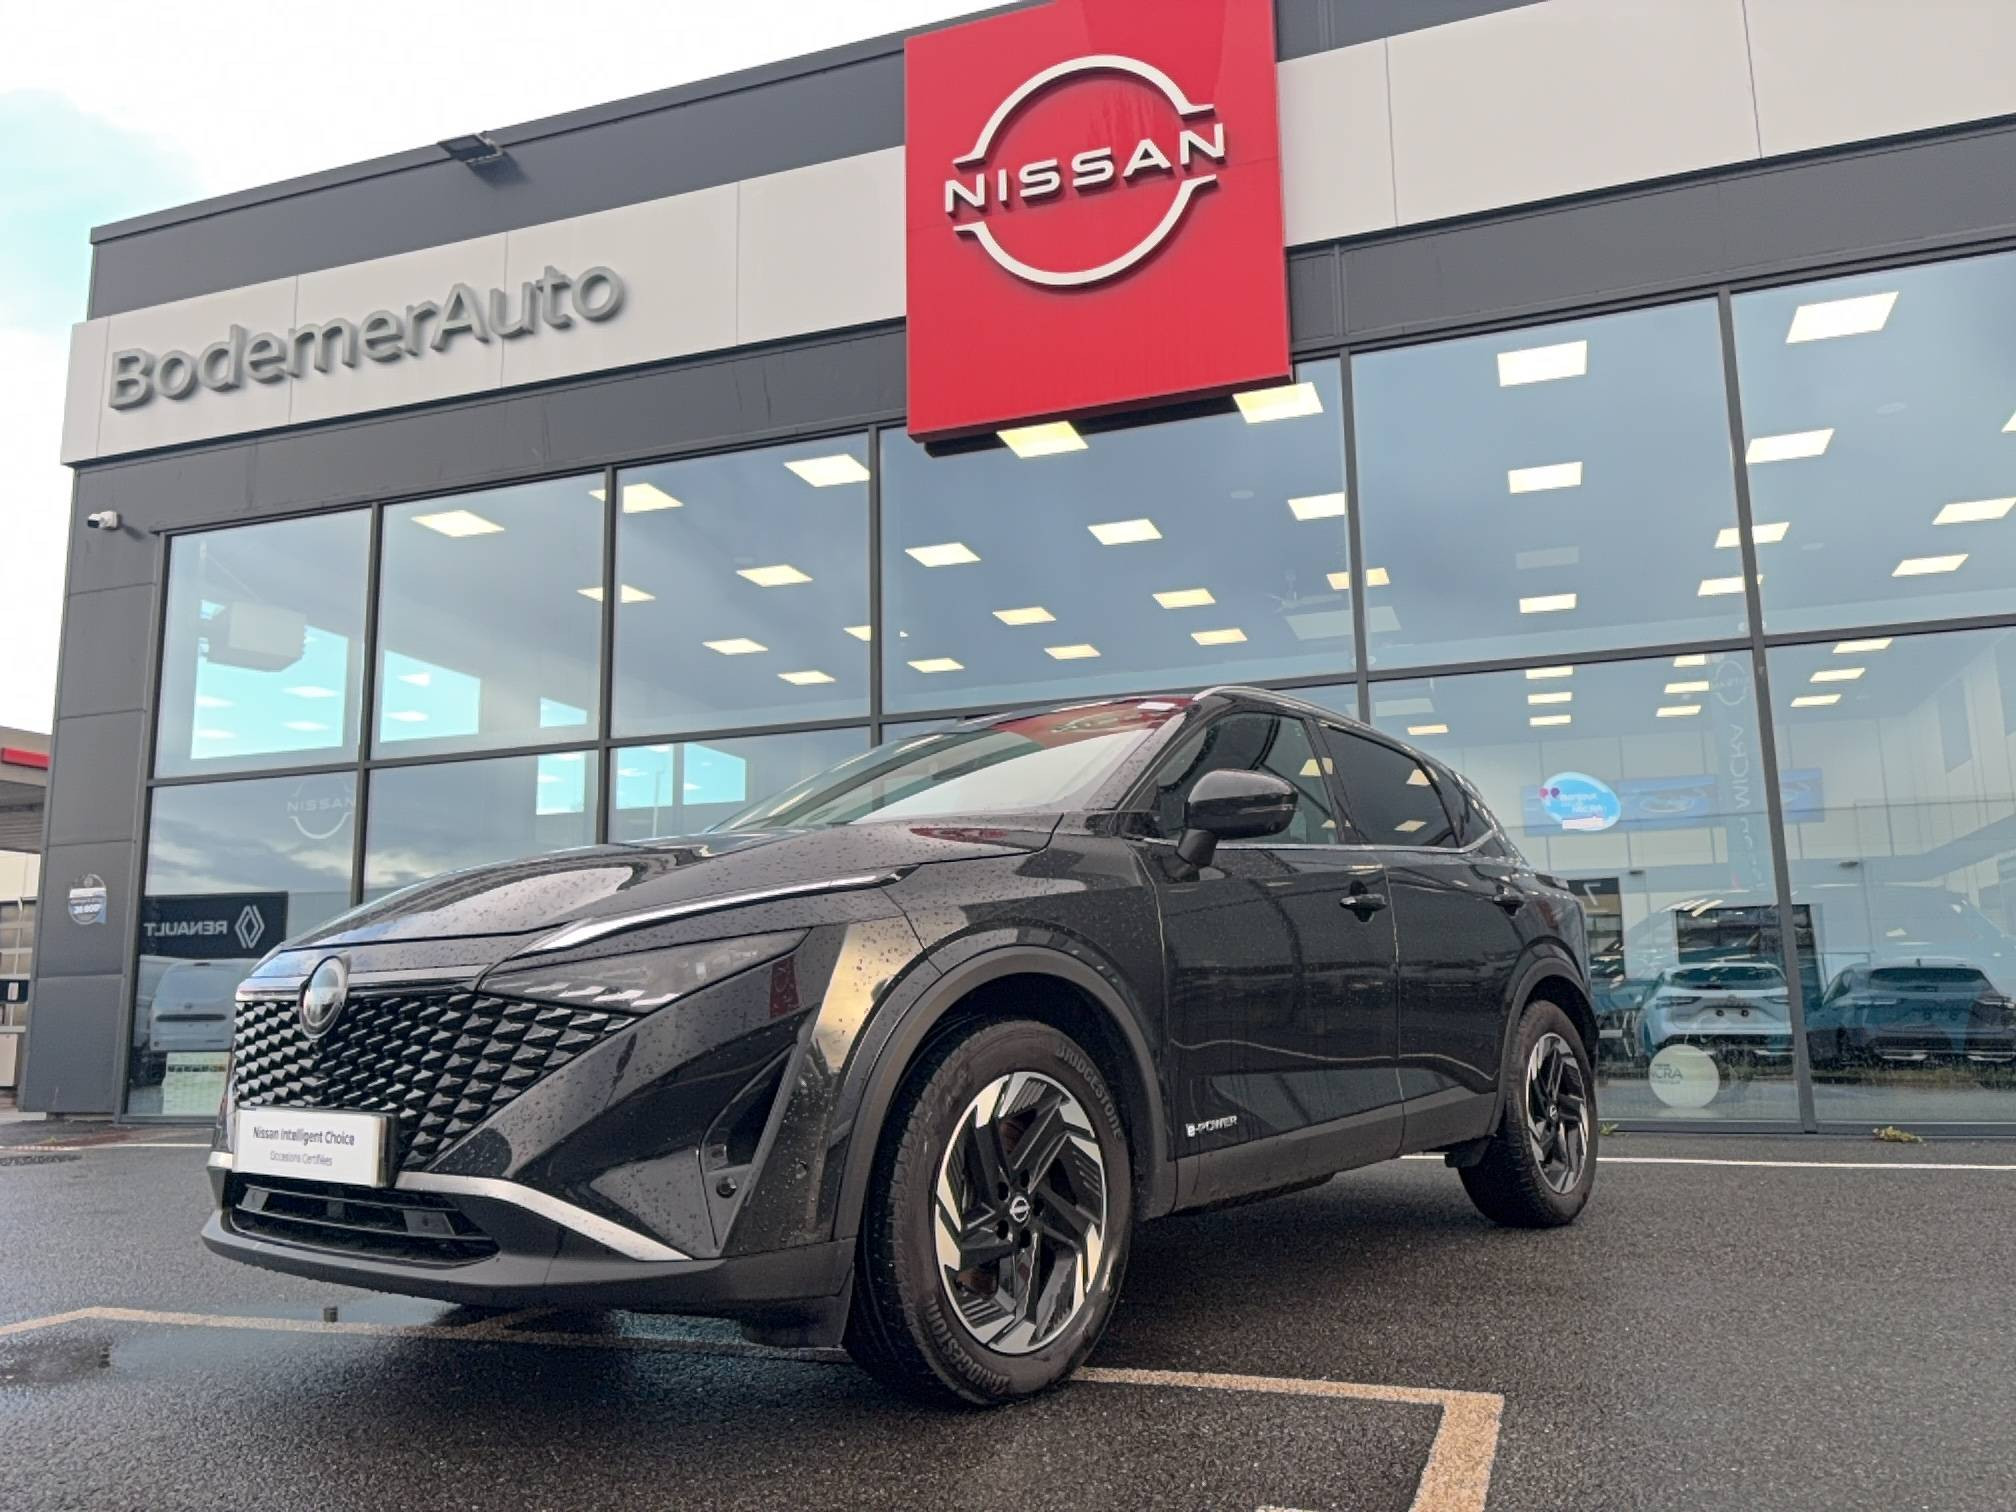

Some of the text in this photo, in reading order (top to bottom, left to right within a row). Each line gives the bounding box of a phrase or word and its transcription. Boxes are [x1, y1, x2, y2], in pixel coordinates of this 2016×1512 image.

[945, 123, 1225, 215] NISSAN
[108, 265, 625, 410] BodemerAuto
[253, 1126, 279, 1140] Nissan
[325, 1131, 355, 1146] Choice
